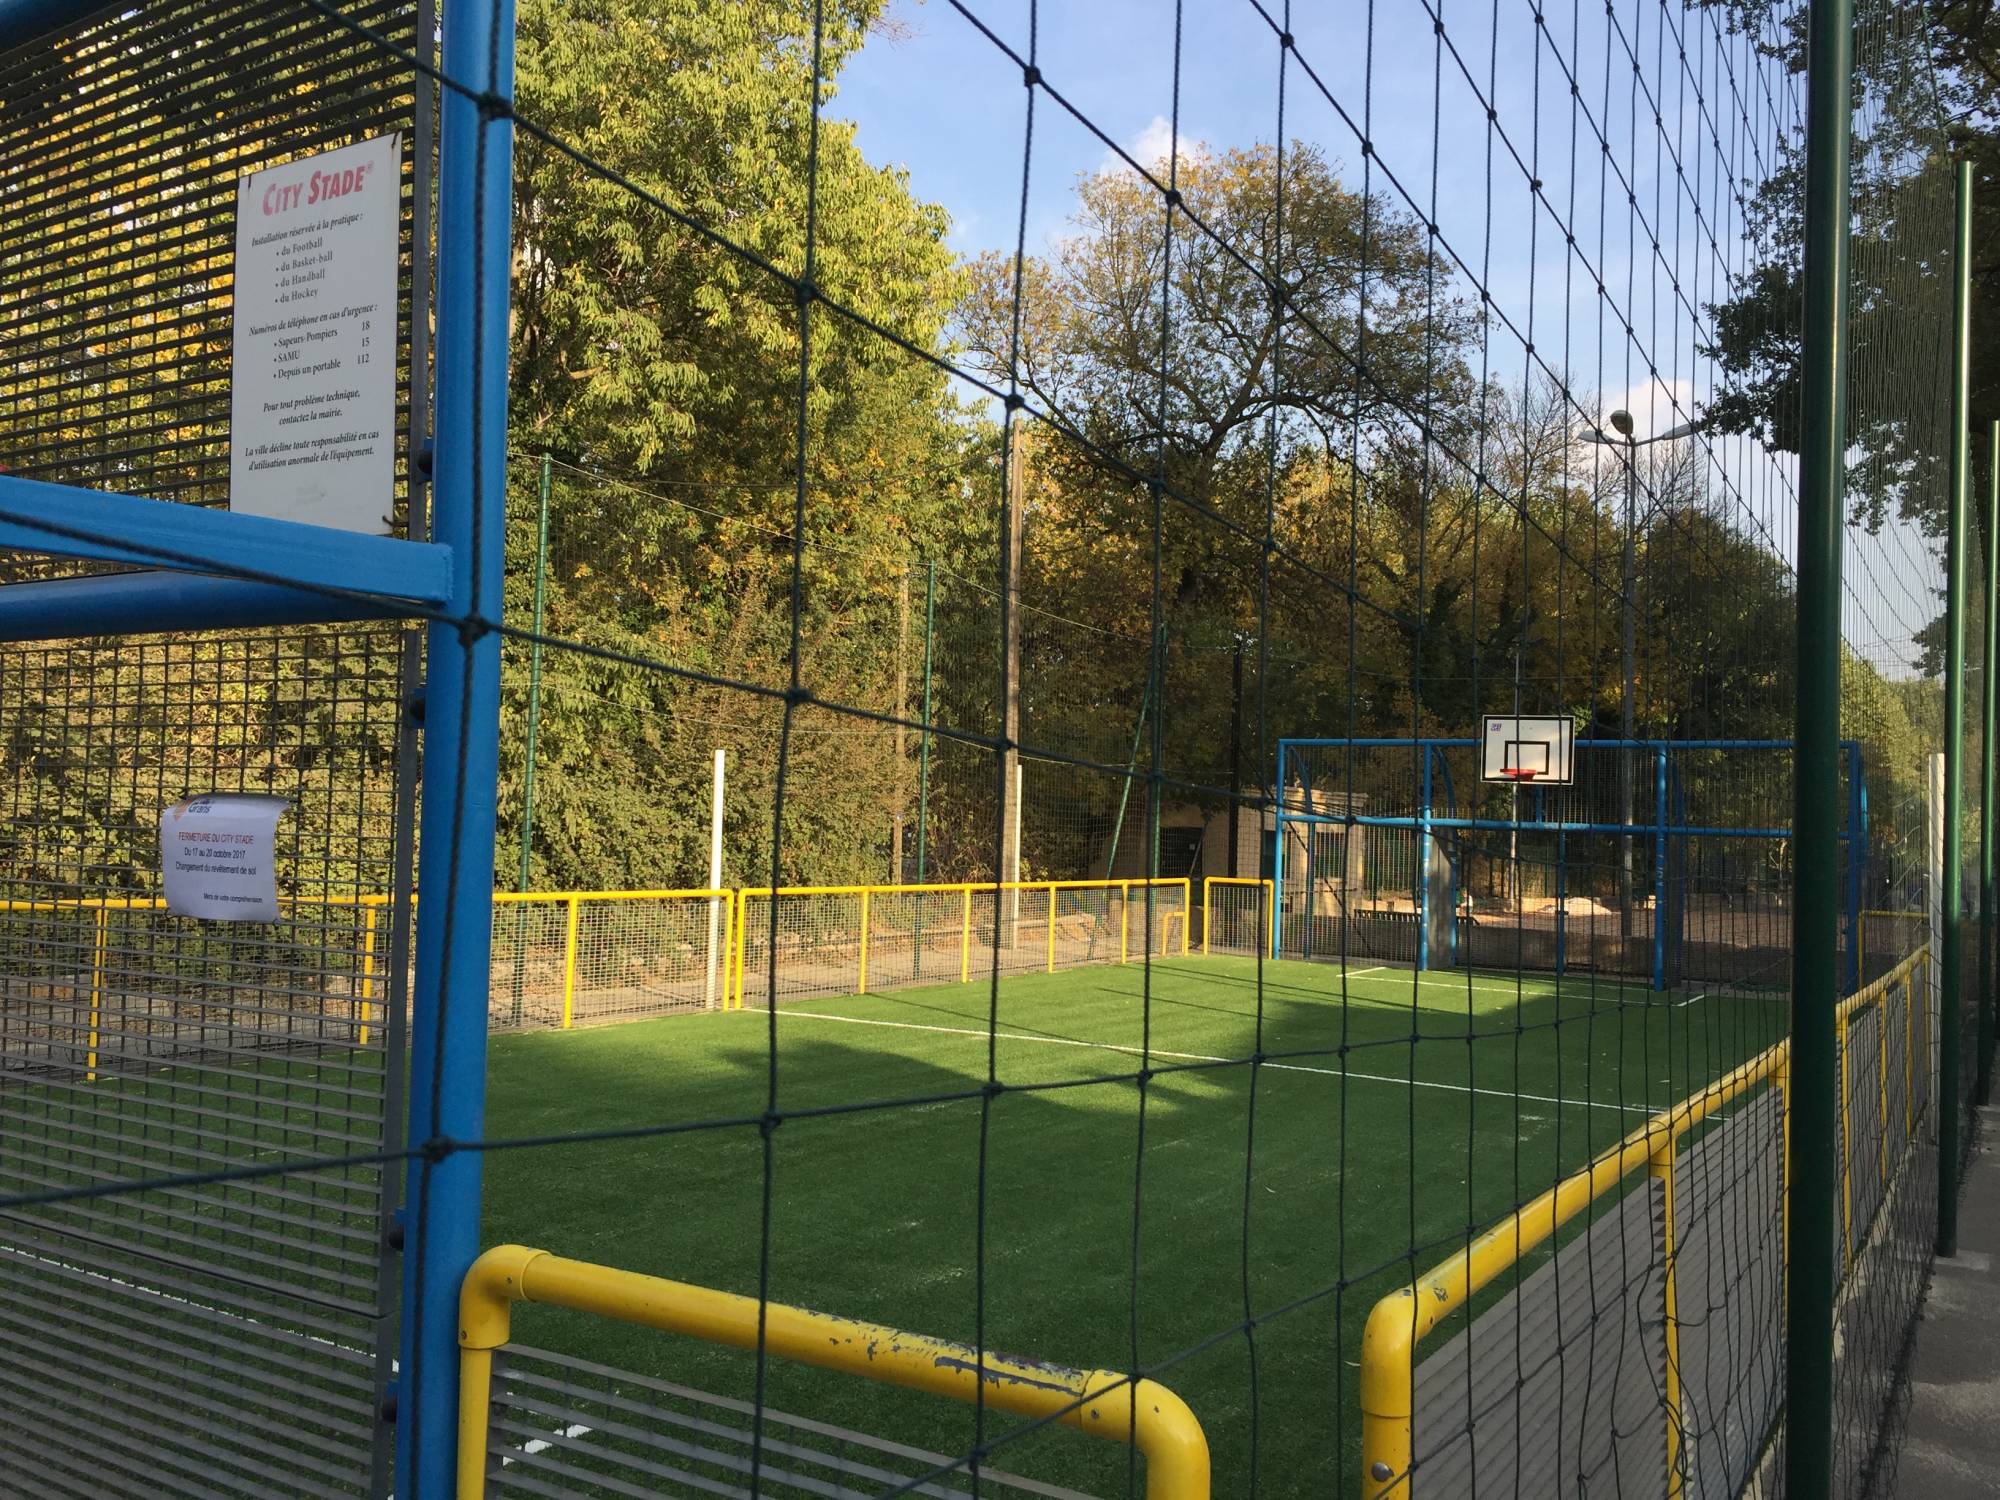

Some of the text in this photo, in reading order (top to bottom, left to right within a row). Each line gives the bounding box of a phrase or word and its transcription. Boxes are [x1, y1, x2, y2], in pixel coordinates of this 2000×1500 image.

[252, 231, 288, 247] Installation
[322, 219, 330, 230] la
[281, 237, 323, 257] du Football
[280, 250, 333, 272] du Basket-ball
[280, 268, 325, 288] du Handball
[280, 287, 318, 304] du Hockey
[249, 324, 278, 336] Numéros
[278, 320, 287, 331] de
[287, 315, 318, 330] téléphone
[320, 313, 328, 322] en
[328, 311, 340, 320] cas
[361, 320, 370, 331] 18
[278, 336, 370, 364] SAMU 15
[278, 353, 370, 380] Depuis un portable 112
[263, 400, 280, 413] Pour
[280, 398, 293, 410] tout
[294, 394, 325, 408] problème
[278, 412, 310, 426] contactez
[310, 410, 318, 421] la
[245, 430, 380, 457] La ville décline toute responsabilité en cas
[248, 456, 287, 472] d'utilisation
[288, 452, 320, 466] anormale
[320, 450, 329, 462] de
[178, 832, 254, 844] FERMETURE DU CITY STADE
[184, 847, 192, 856] Du
[213, 849, 232, 858] octobre
[232, 850, 246, 860] 2017
[176, 860, 204, 872] Changement
[240, 866, 248, 875] de
[248, 866, 256, 876] sol
